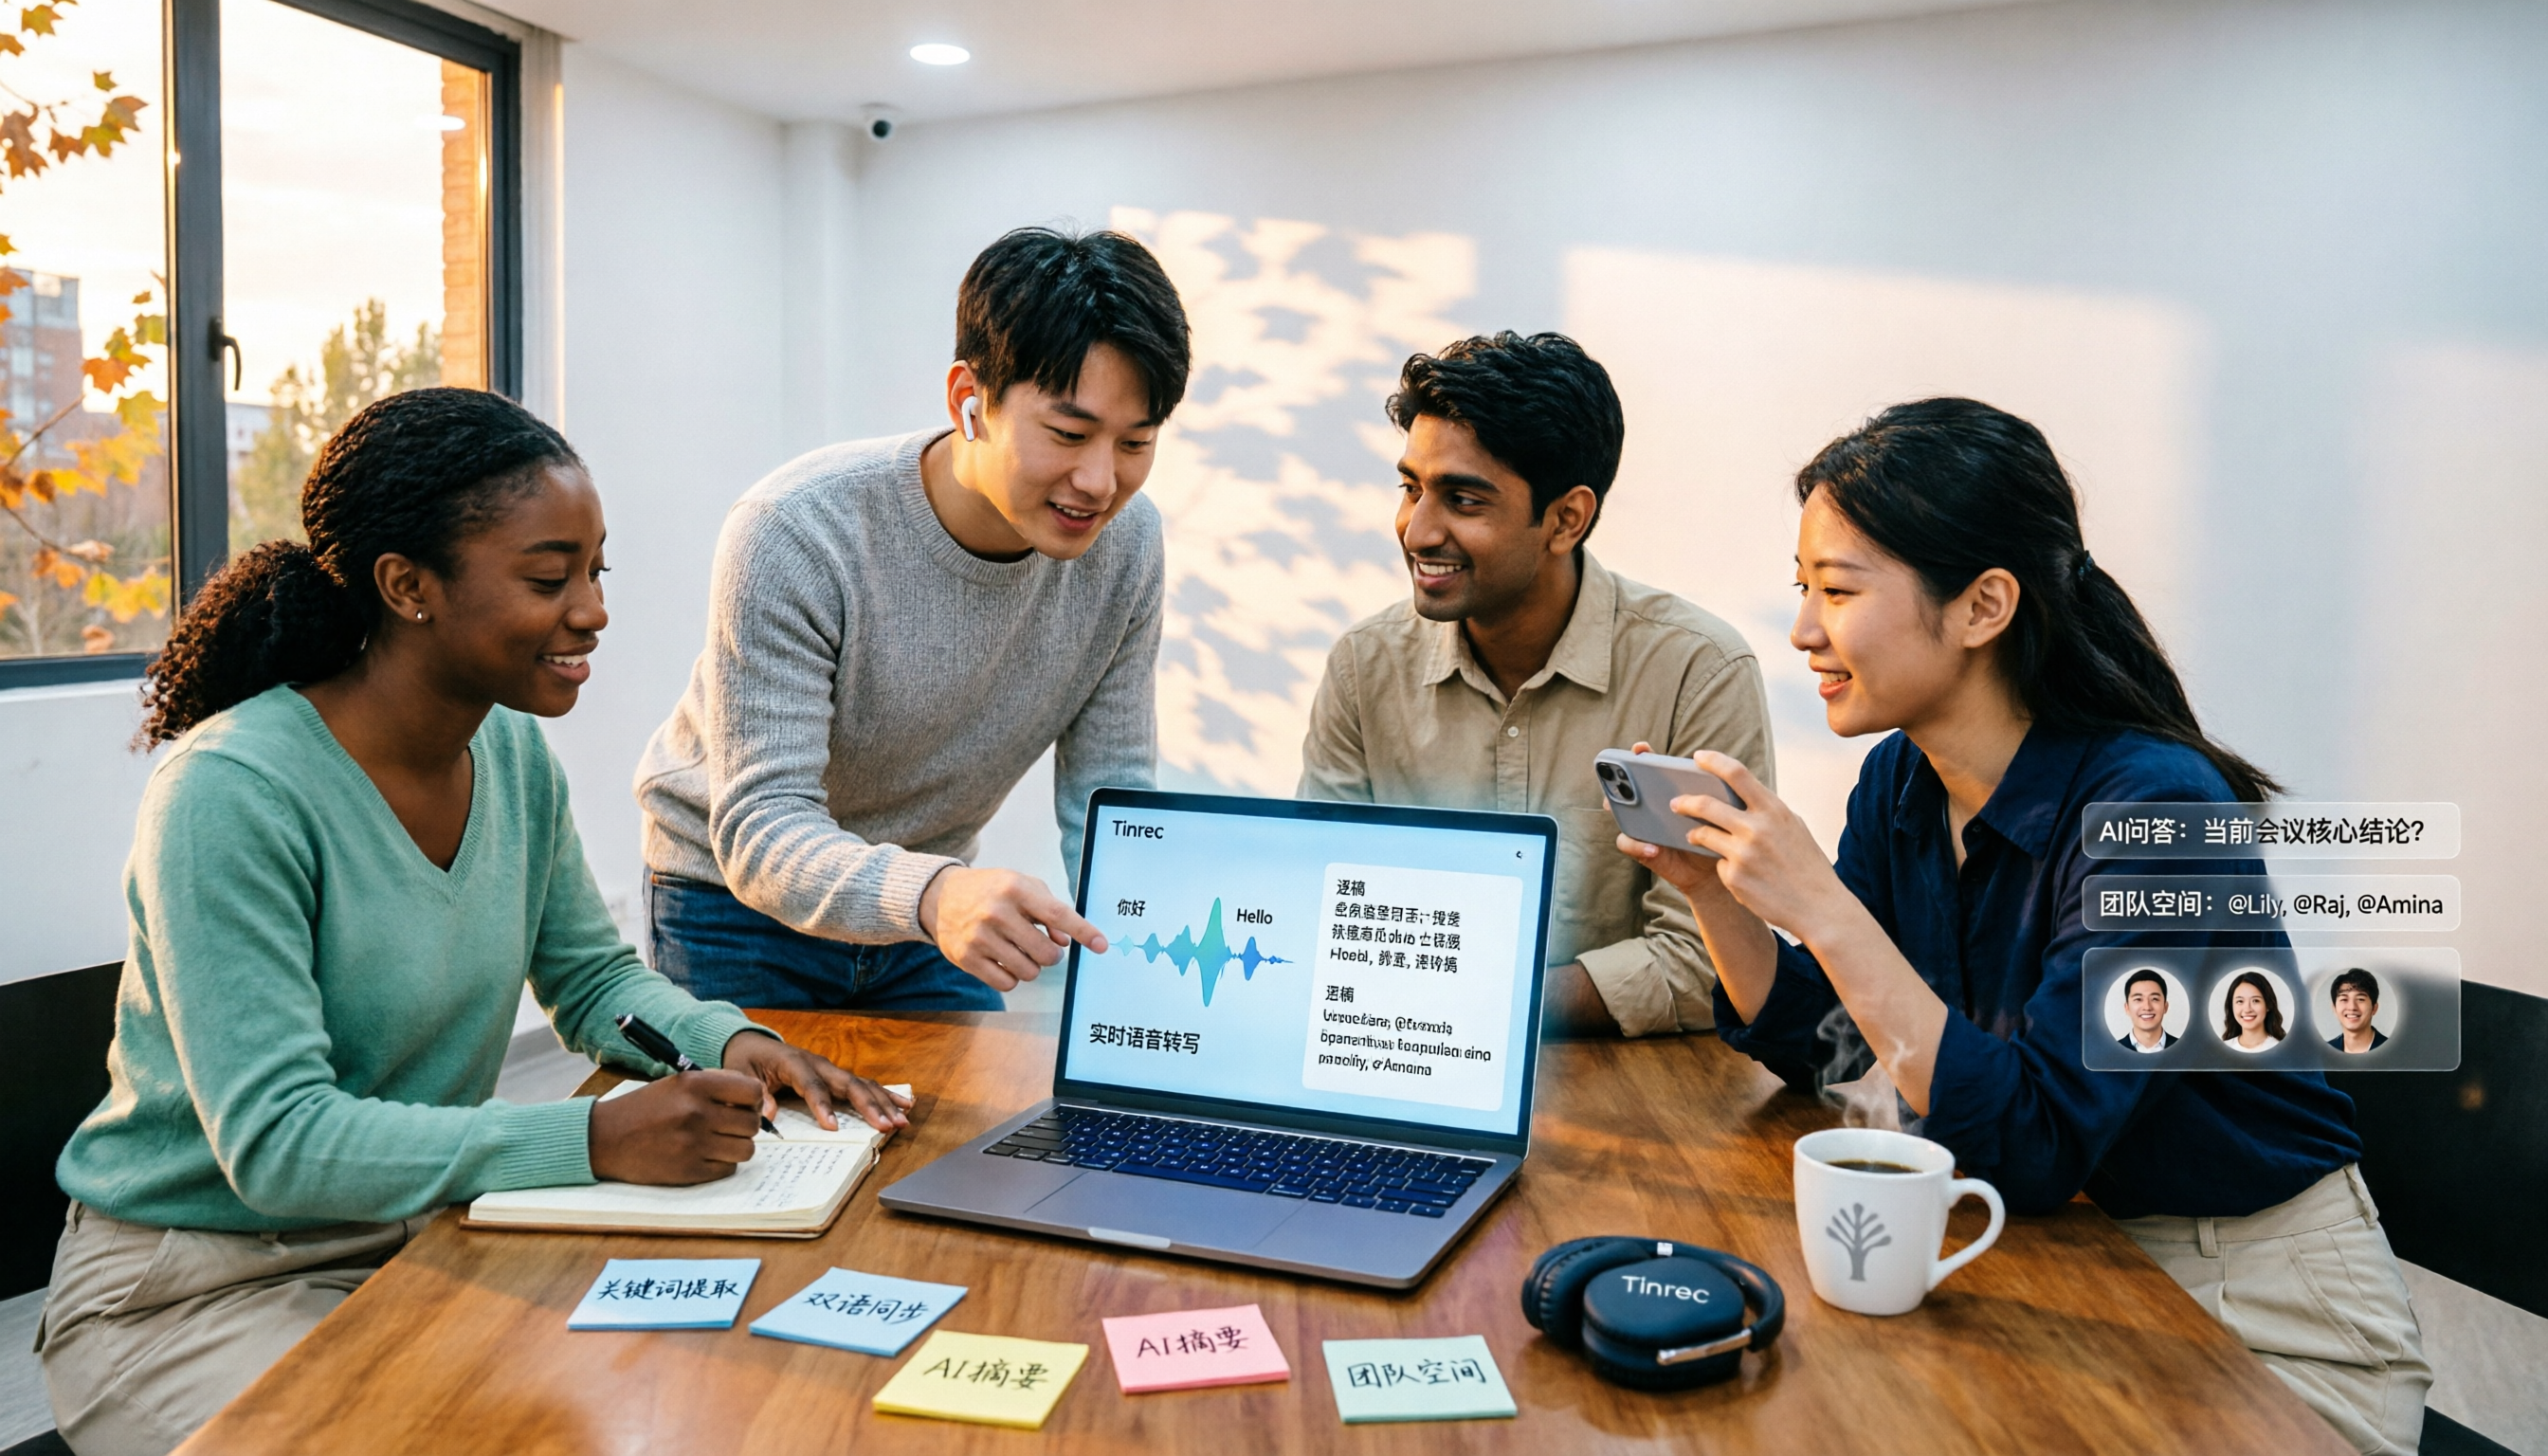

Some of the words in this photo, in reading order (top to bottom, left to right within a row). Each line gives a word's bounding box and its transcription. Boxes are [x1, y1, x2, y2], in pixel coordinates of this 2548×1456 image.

[1112, 819, 1165, 840] Tinrec
[1117, 898, 1146, 918] 你好
[1236, 907, 1273, 925] Hello
[1089, 1022, 1201, 1055] 实时语音转写
[596, 1278, 740, 1301] 关键词提取
[1622, 1275, 1711, 1305] Tinrec
[802, 1291, 930, 1324] 双语同步
[1137, 1325, 1250, 1358] AI摘要
[922, 1356, 1050, 1390] AI摘要
[1347, 1356, 1487, 1389] 团队空间
